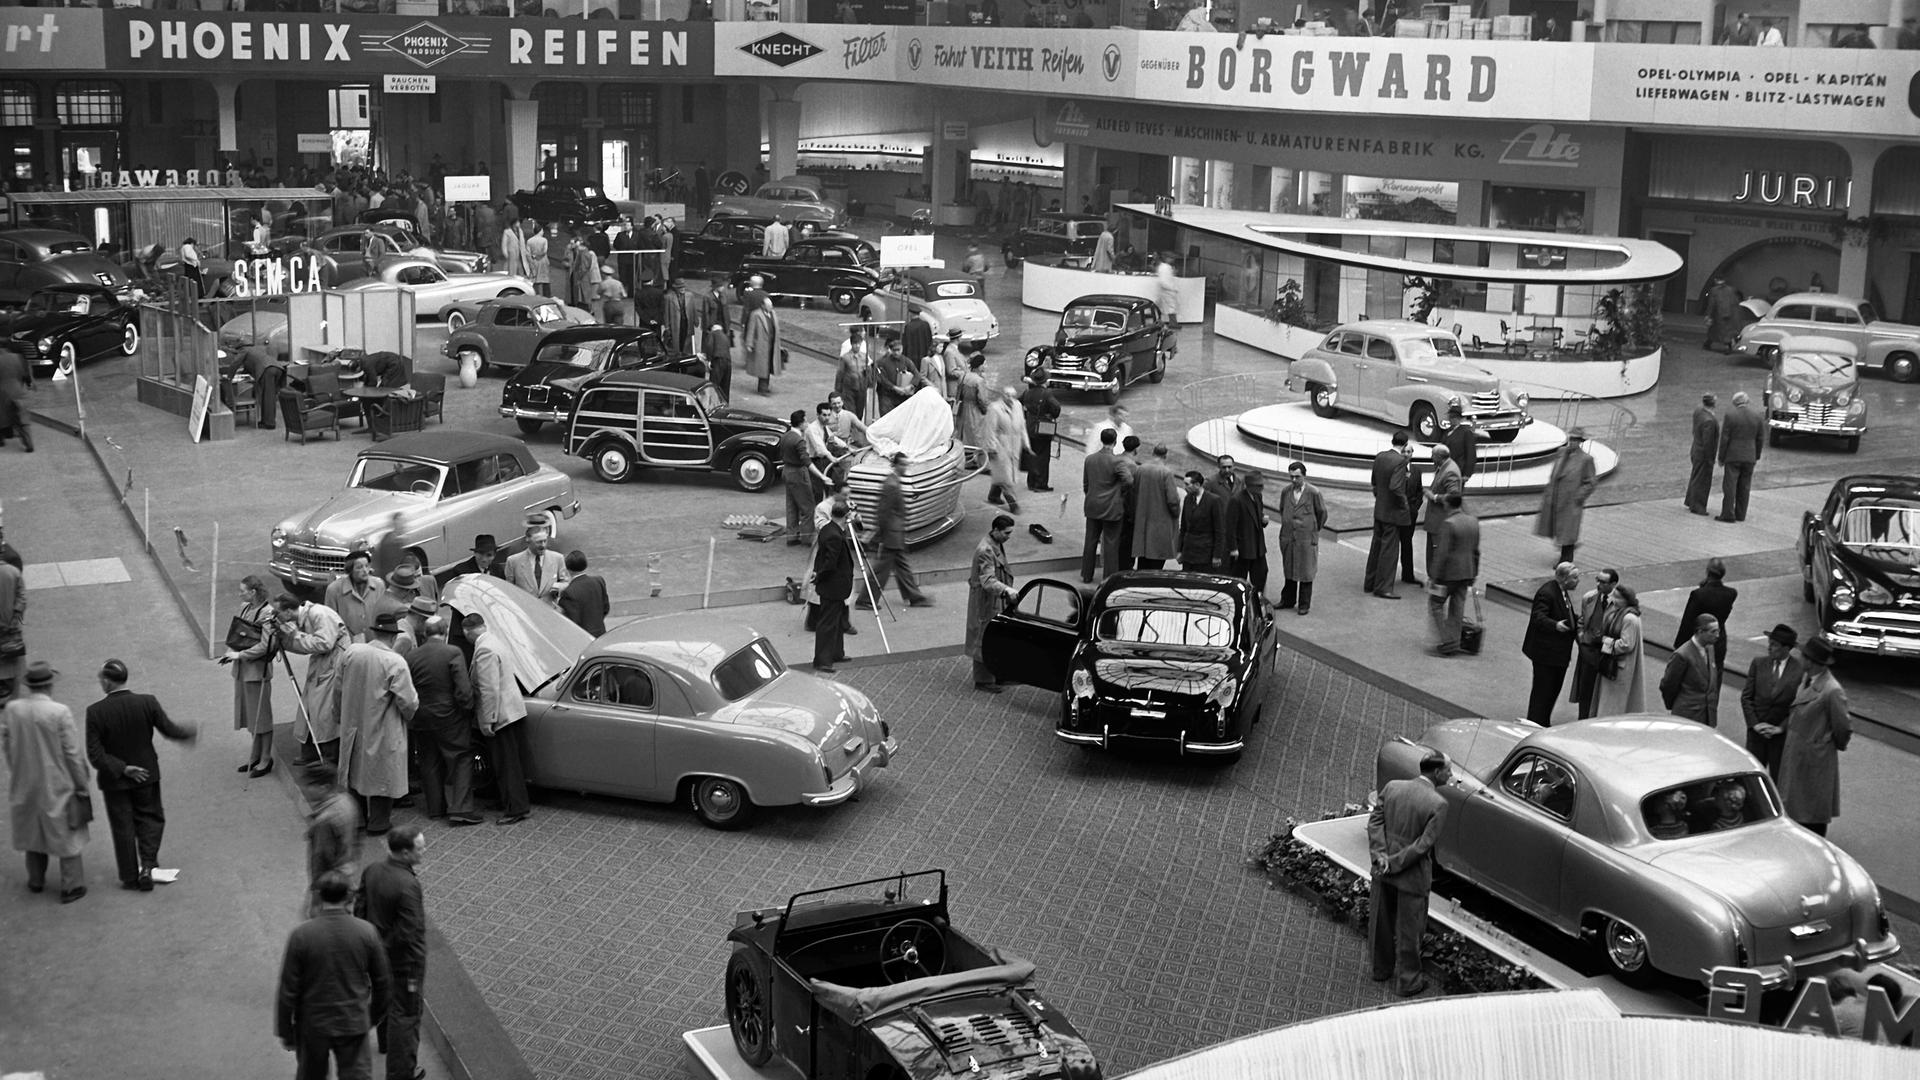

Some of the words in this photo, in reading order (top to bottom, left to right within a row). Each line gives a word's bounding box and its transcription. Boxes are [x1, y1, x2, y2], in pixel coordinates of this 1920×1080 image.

[129, 20, 351, 61] PHOENIX
[404, 36, 448, 48] PHOENIX
[510, 28, 688, 66] REIFEN
[751, 43, 812, 56] KNECHT
[842, 31, 888, 70] Filter
[934, 44, 967, 68] Fahrt
[970, 46, 1034, 72] VEITH
[1041, 46, 1085, 82] Reifen
[1140, 58, 1180, 71] GEGENÜBER
[1186, 45, 1498, 103] BORGWARD
[1636, 87, 1730, 102] LIEFERWAGEN
[1096, 117, 1130, 133] ALFRED
[1135, 121, 1165, 137] TEVES
[1261, 133, 1434, 157] ARMATURENFABRIK
[1454, 143, 1485, 159] KG.
[234, 255, 321, 297] SIMCA
